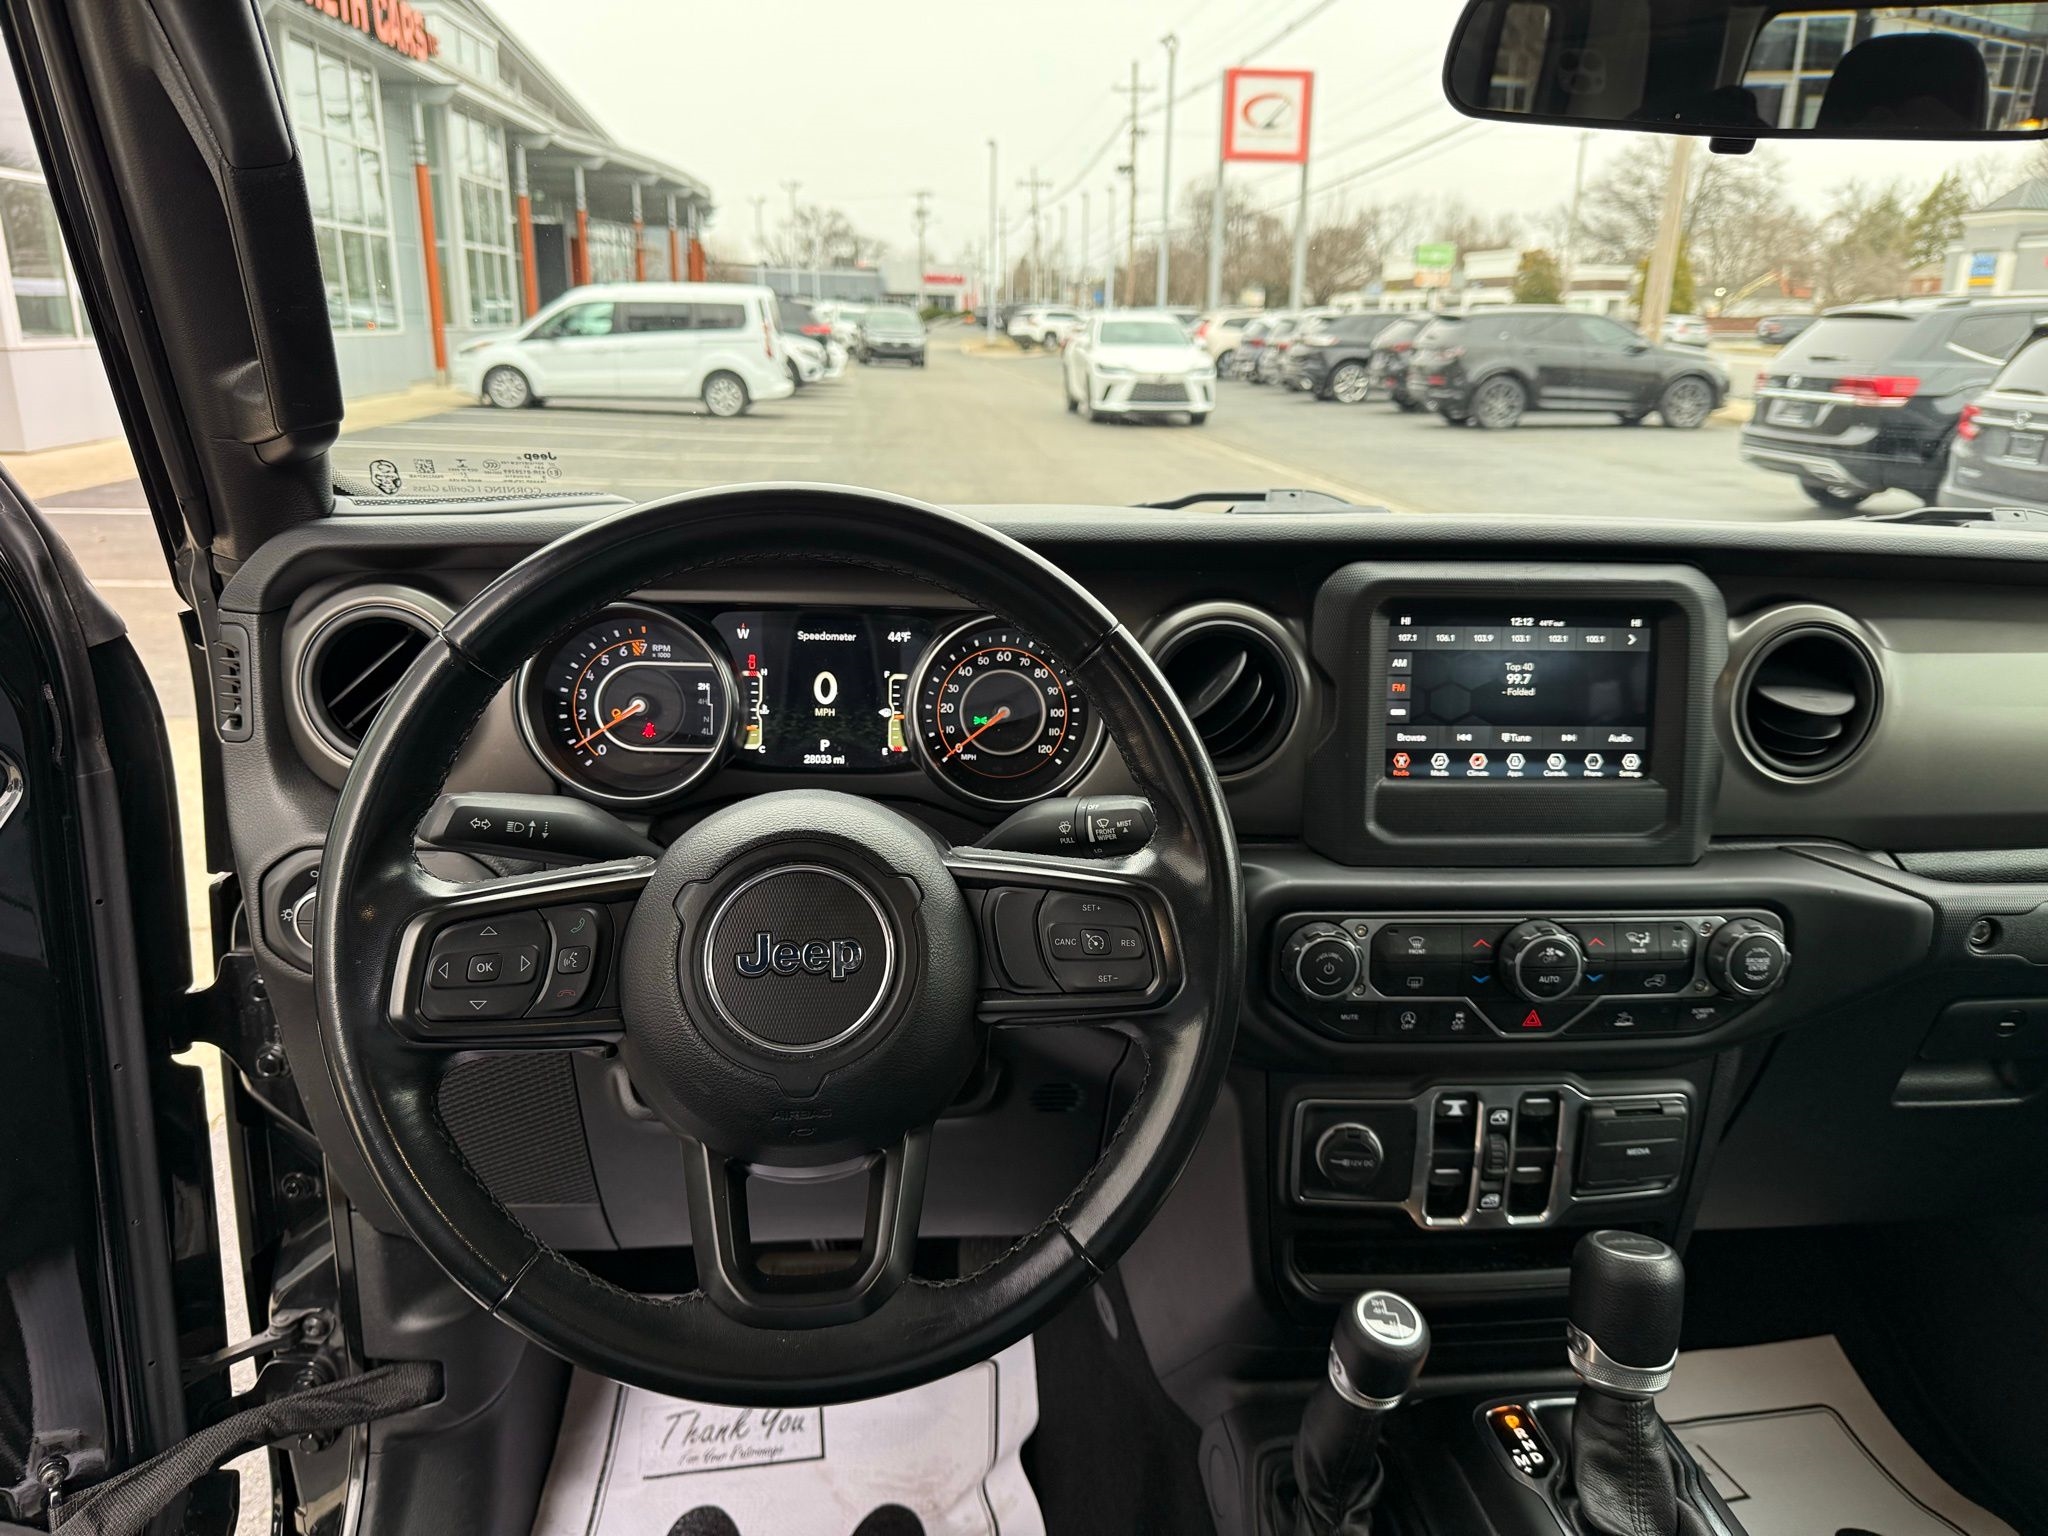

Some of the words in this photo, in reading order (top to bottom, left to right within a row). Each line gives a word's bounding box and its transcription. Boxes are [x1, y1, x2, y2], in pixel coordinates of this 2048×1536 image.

[1510, 617, 1535, 626] 12:12
[737, 629, 750, 640] W
[797, 631, 857, 642] Speedometer
[619, 646, 628, 657] 6
[640, 643, 648, 654] 7
[652, 644, 671, 652] RPM
[601, 655, 610, 666] 5
[977, 656, 990, 665] 50
[996, 652, 1012, 662] 60
[1019, 657, 1031, 667] 70
[1392, 658, 1408, 668] AM
[1505, 662, 1521, 672] Top
[1522, 662, 1535, 671] 40
[585, 670, 595, 681] 4
[958, 666, 973, 677] 40
[1034, 668, 1049, 679] 80
[1506, 673, 1532, 685] 99.7
[813, 671, 838, 705] 0
[947, 685, 959, 693] 30
[1047, 687, 1058, 695] 90
[1392, 683, 1406, 692] FM
[1507, 688, 1536, 696] Folded
[579, 688, 587, 700] 3
[815, 708, 836, 717] MPH
[941, 703, 955, 713] 20
[578, 709, 587, 720] 2
[1050, 709, 1064, 718] 100
[946, 726, 955, 734] 10
[1049, 728, 1060, 736] 110
[1396, 732, 1427, 742] Browse
[1511, 733, 1533, 742] Tune
[1608, 733, 1634, 743] Audio
[597, 744, 607, 755] 0
[820, 739, 830, 752] P
[1038, 744, 1053, 754] 120
[804, 754, 832, 764] 28033
[833, 754, 845, 764] mi
[1116, 819, 1132, 828] MIST
[1095, 827, 1116, 835] FRONT
[1054, 938, 1077, 946] CANC
[1120, 939, 1136, 947] RES
[1671, 939, 1688, 948] A/C
[737, 932, 863, 979] Jeep
[476, 962, 493, 973] OK
[1538, 975, 1560, 983] AUTO
[772, 1109, 833, 1121] AIRBAG
[1626, 1147, 1651, 1156] MEDIA
[661, 1408, 752, 1451] Thank
[761, 1409, 806, 1440] You
[1513, 1427, 1529, 1440] R
[1521, 1439, 1538, 1452] N
[1512, 1454, 1532, 1467] M
[1529, 1452, 1545, 1464] D
